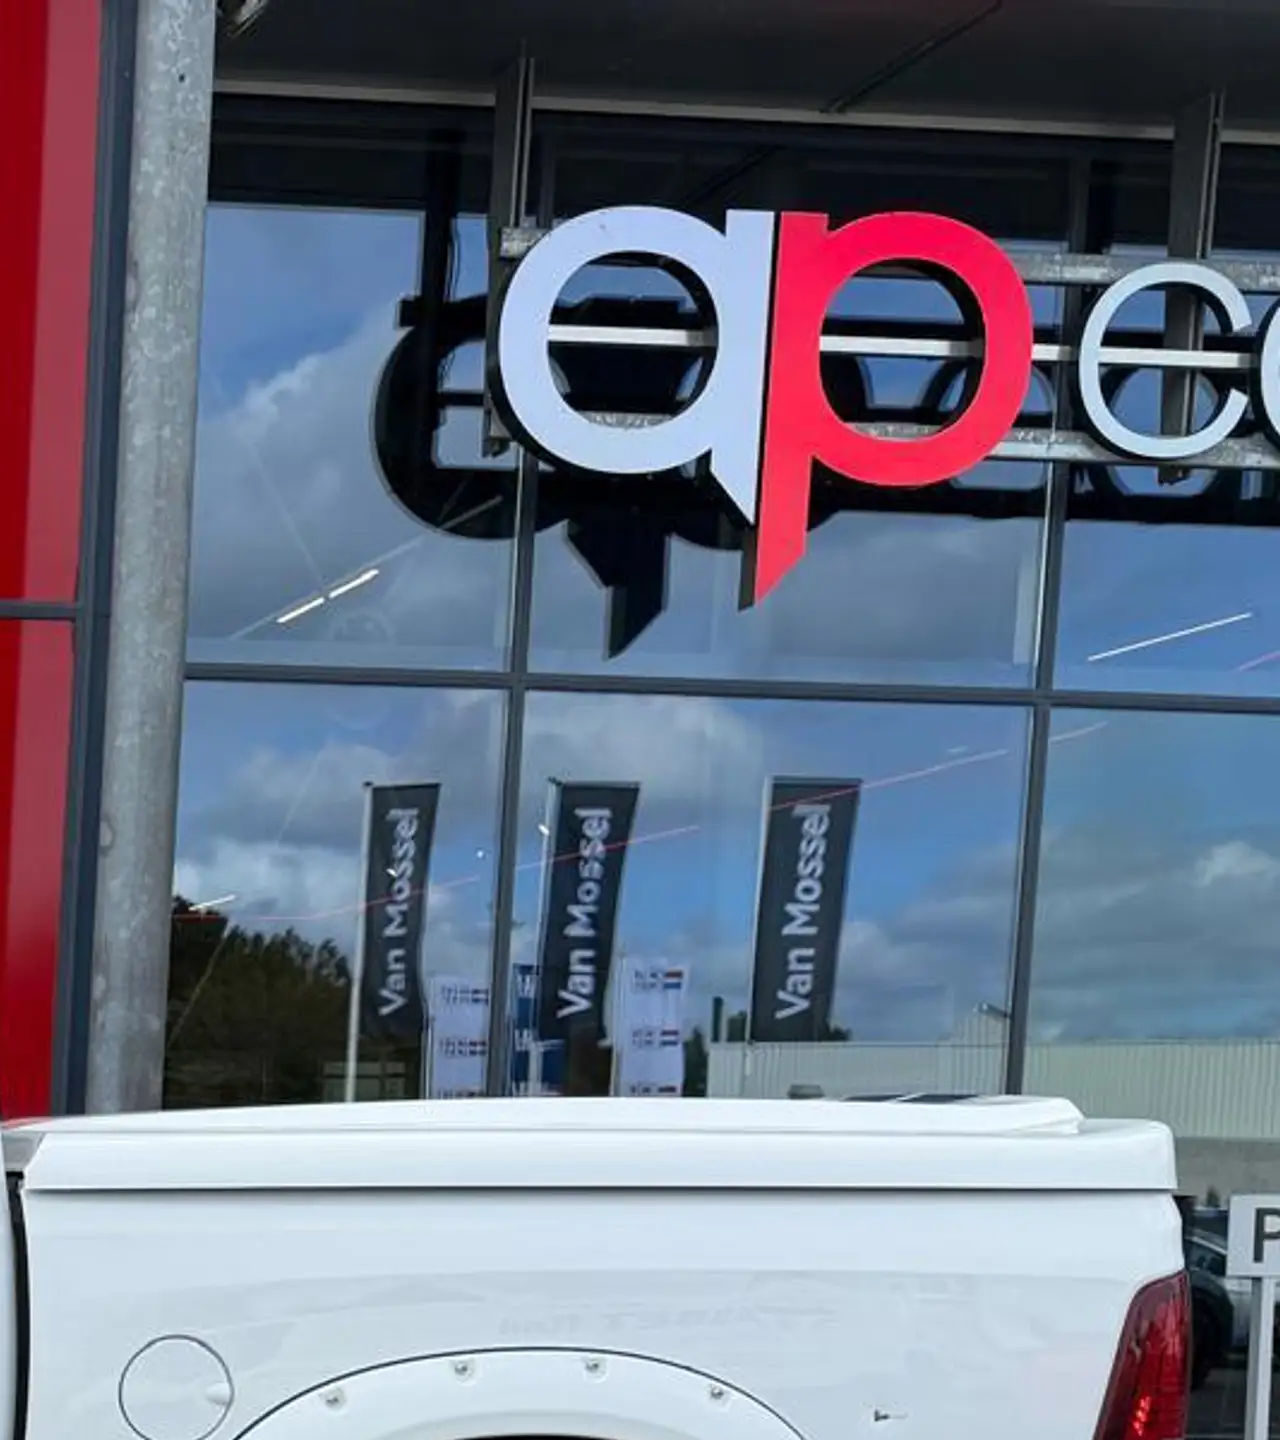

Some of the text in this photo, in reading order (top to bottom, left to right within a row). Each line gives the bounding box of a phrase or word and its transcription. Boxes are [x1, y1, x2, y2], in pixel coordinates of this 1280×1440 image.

[1078, 263, 1280, 459] c
[378, 808, 419, 1017] Van Mossel
[555, 808, 613, 1018] Van Mossel
[774, 804, 831, 1019] Van Mossel
